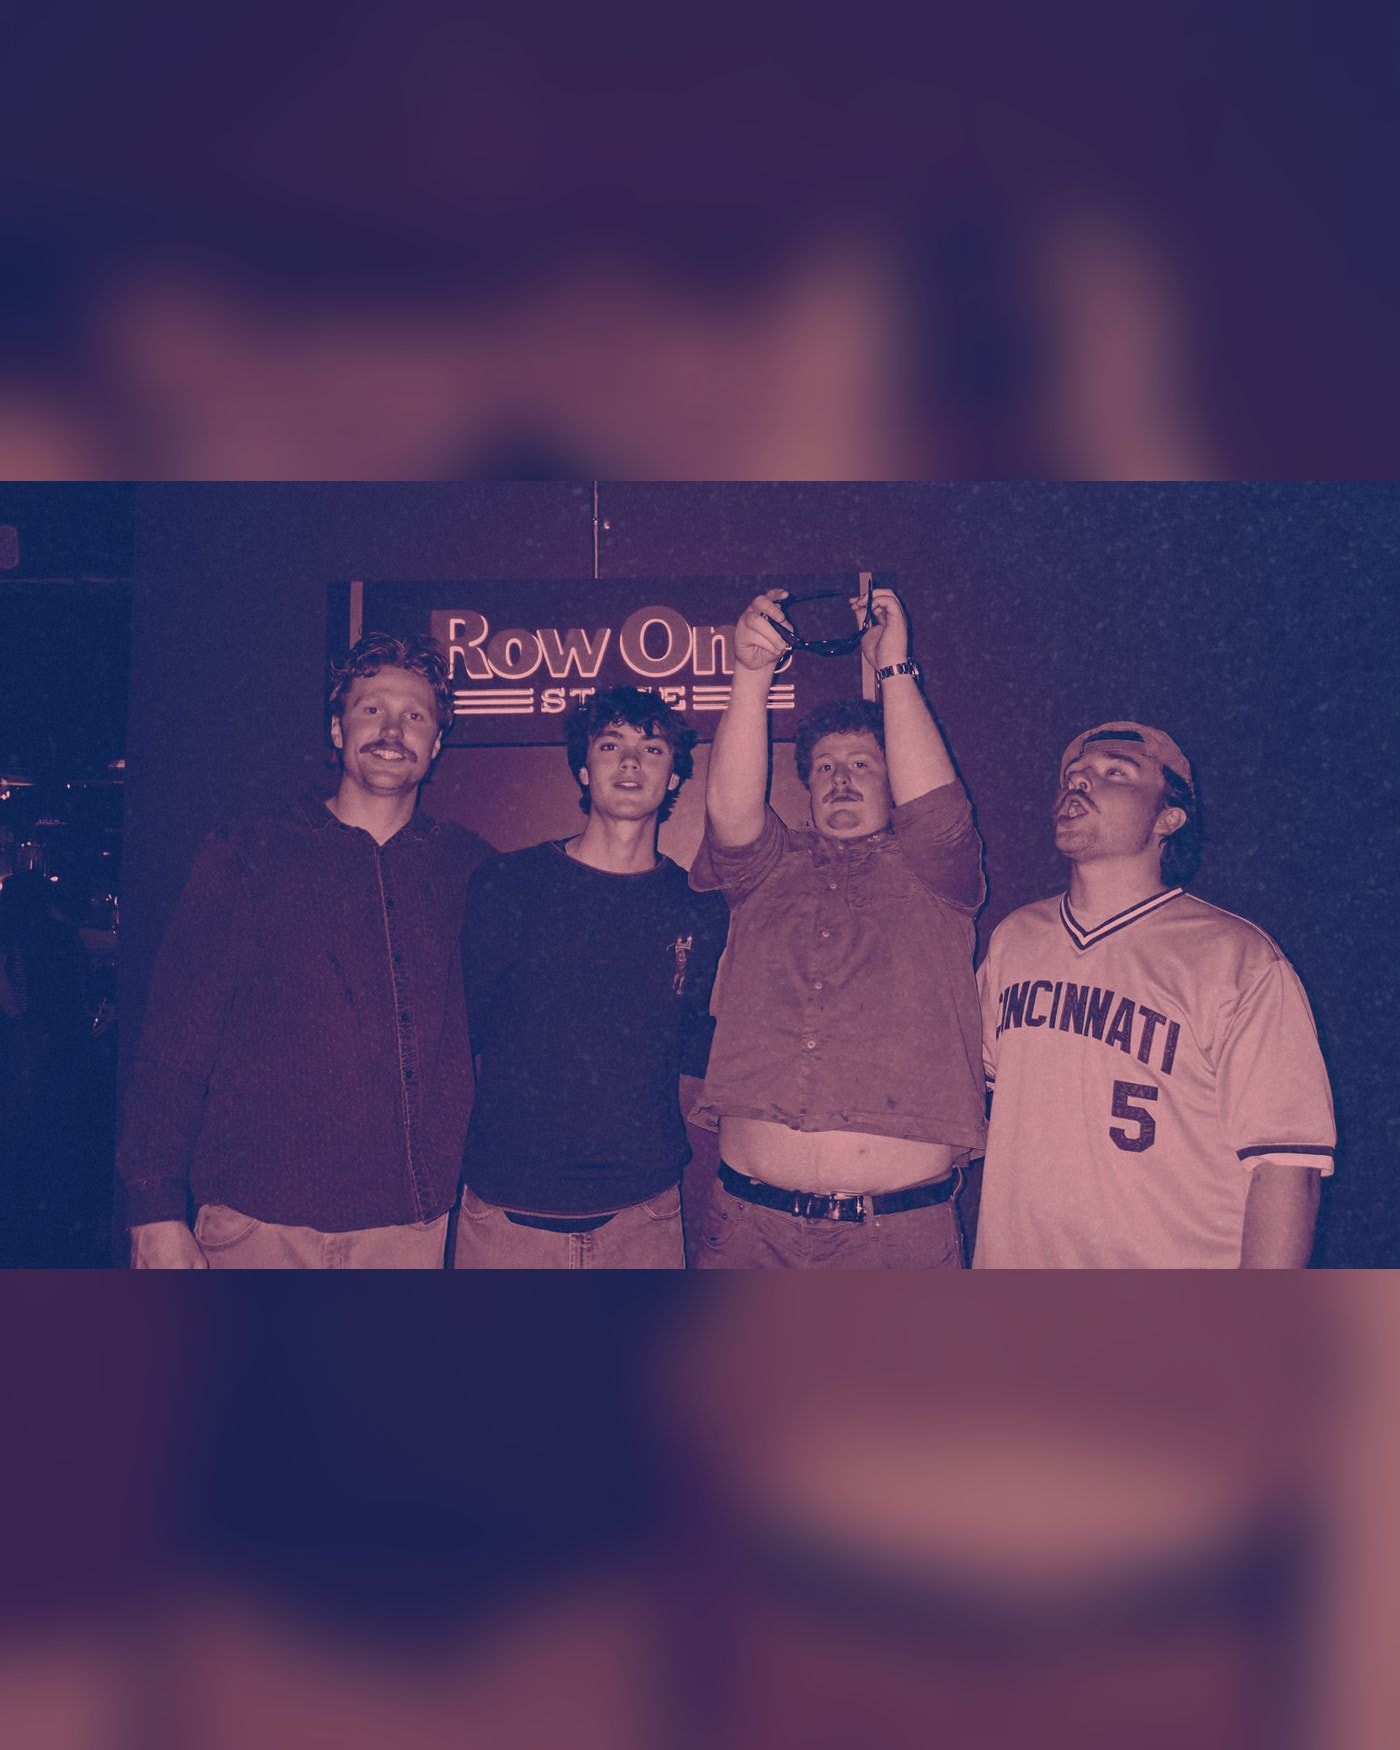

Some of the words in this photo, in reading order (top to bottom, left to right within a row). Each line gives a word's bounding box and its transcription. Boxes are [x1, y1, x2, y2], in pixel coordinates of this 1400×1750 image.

[431, 609, 611, 679] Row
[619, 605, 793, 679] On
[541, 686, 686, 713] STE
[1109, 1079, 1158, 1153] 5
